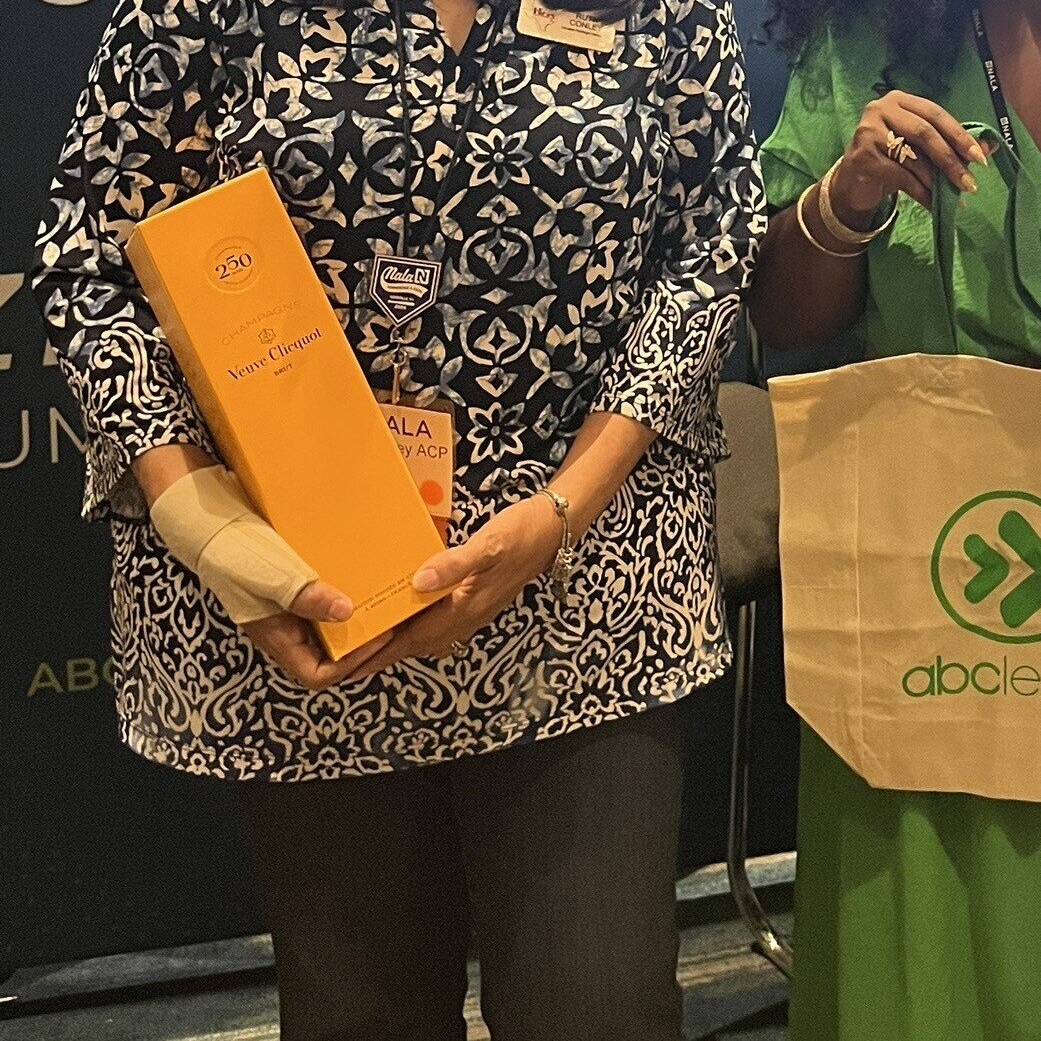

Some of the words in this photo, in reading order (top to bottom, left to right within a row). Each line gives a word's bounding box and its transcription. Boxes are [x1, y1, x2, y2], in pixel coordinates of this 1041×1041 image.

[215, 253, 252, 280] 250
[227, 357, 267, 380] Veuve
[268, 327, 322, 361] Clicquot
[416, 444, 449, 459] ACP
